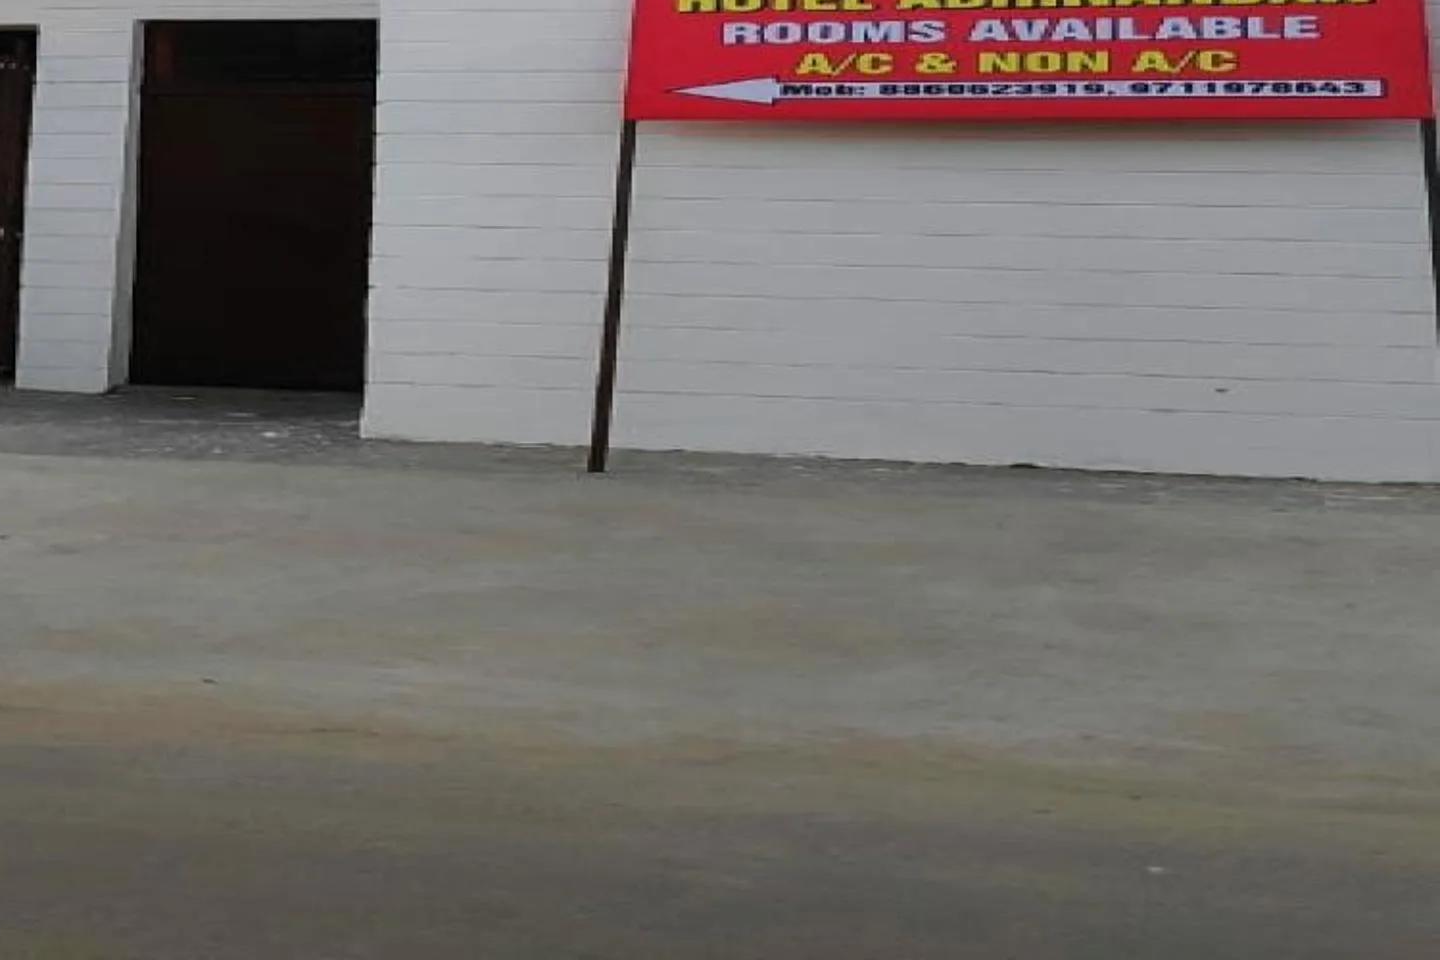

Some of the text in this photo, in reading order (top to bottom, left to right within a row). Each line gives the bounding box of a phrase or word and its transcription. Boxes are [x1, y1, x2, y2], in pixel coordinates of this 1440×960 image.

[722, 16, 1322, 44] ROOMS AVAILABLE
[795, 50, 1239, 74] A/C & NON A/C
